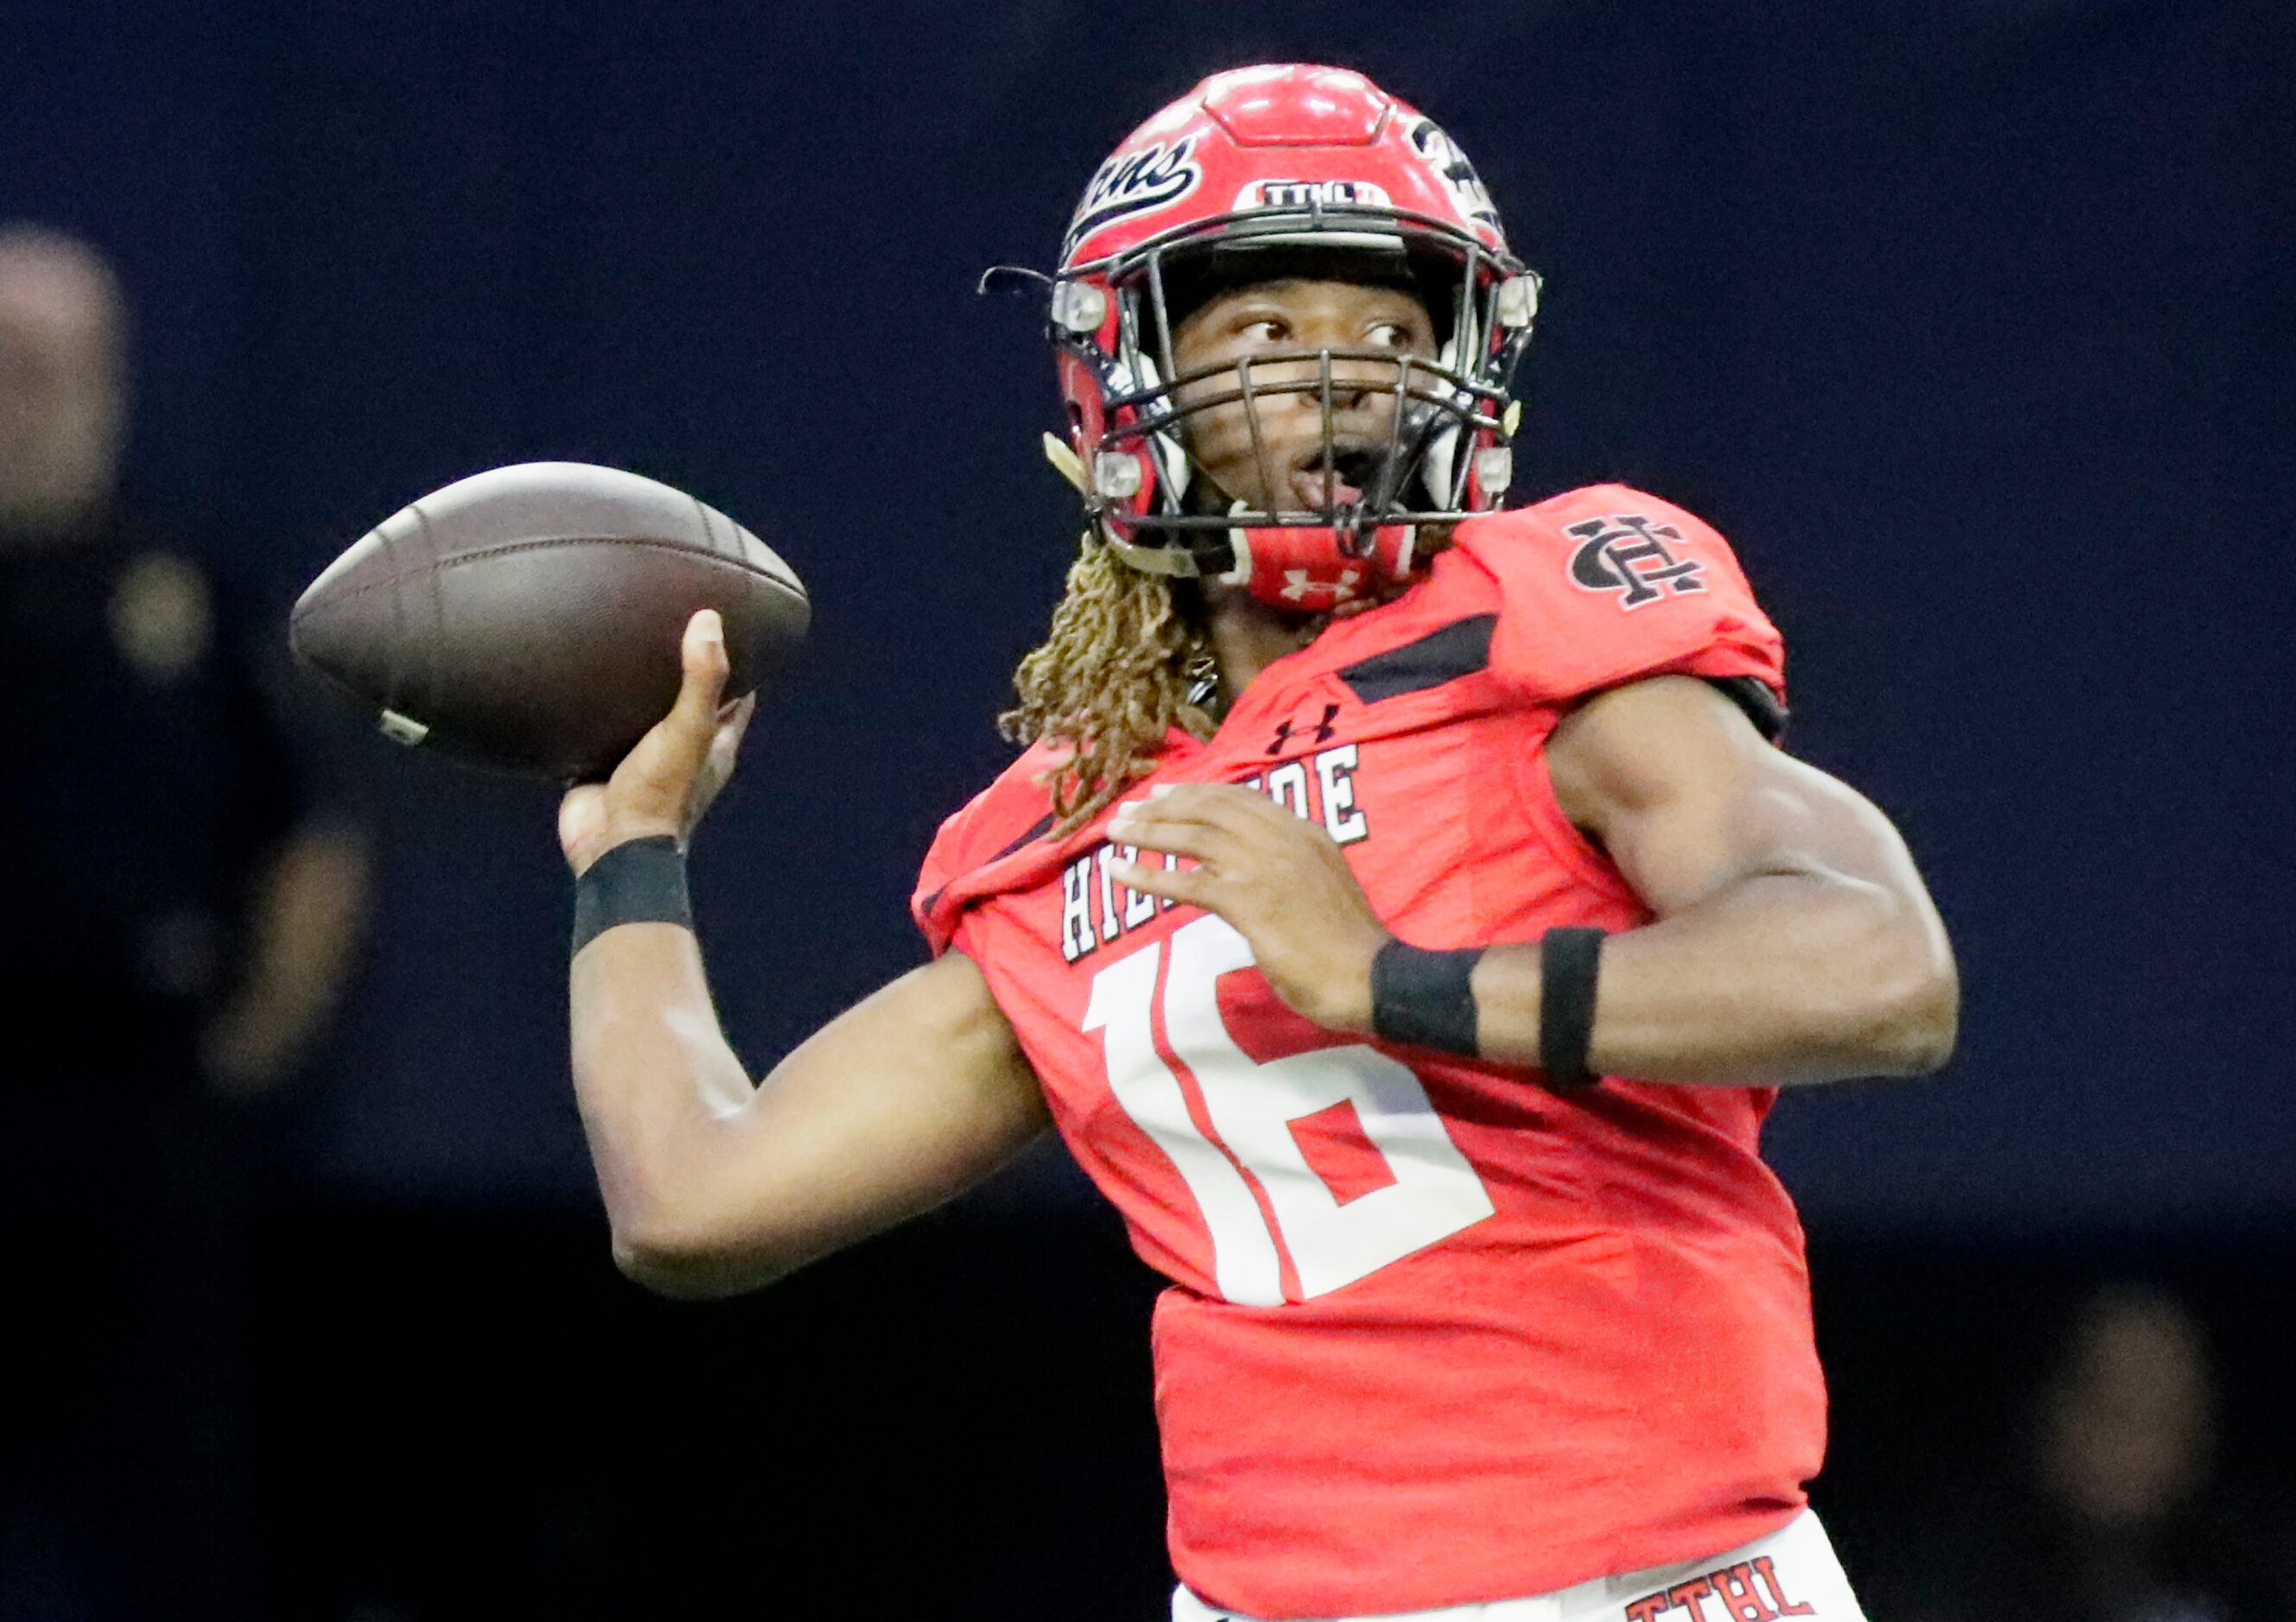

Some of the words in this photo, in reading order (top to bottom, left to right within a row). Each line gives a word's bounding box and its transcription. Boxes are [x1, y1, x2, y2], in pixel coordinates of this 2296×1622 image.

[1264, 178, 1354, 207] TTHL
[1061, 743, 1369, 964] HILDE
[1081, 912, 1496, 1308] 16
